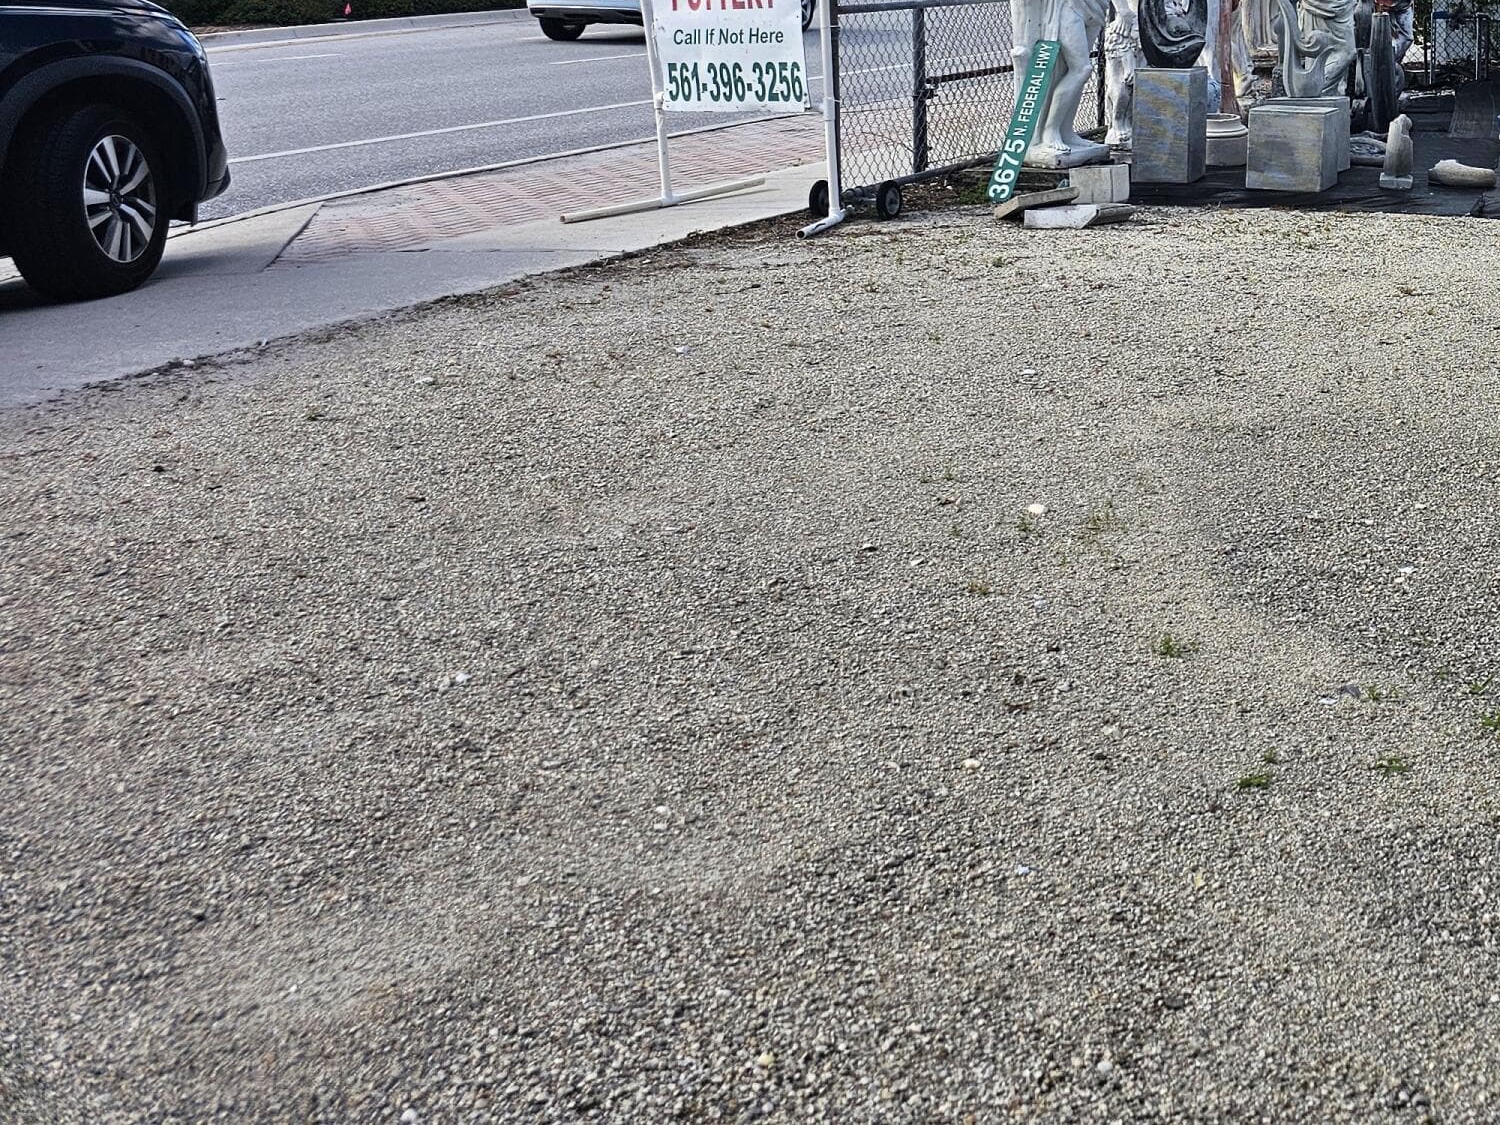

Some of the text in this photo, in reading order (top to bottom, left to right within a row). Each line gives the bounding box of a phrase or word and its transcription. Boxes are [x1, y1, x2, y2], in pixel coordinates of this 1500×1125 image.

[673, 27, 784, 45] Call If Not Here
[667, 61, 803, 103] 561-396-3256
[988, 42, 1054, 199] 3675 N. FEDERAL HWY
